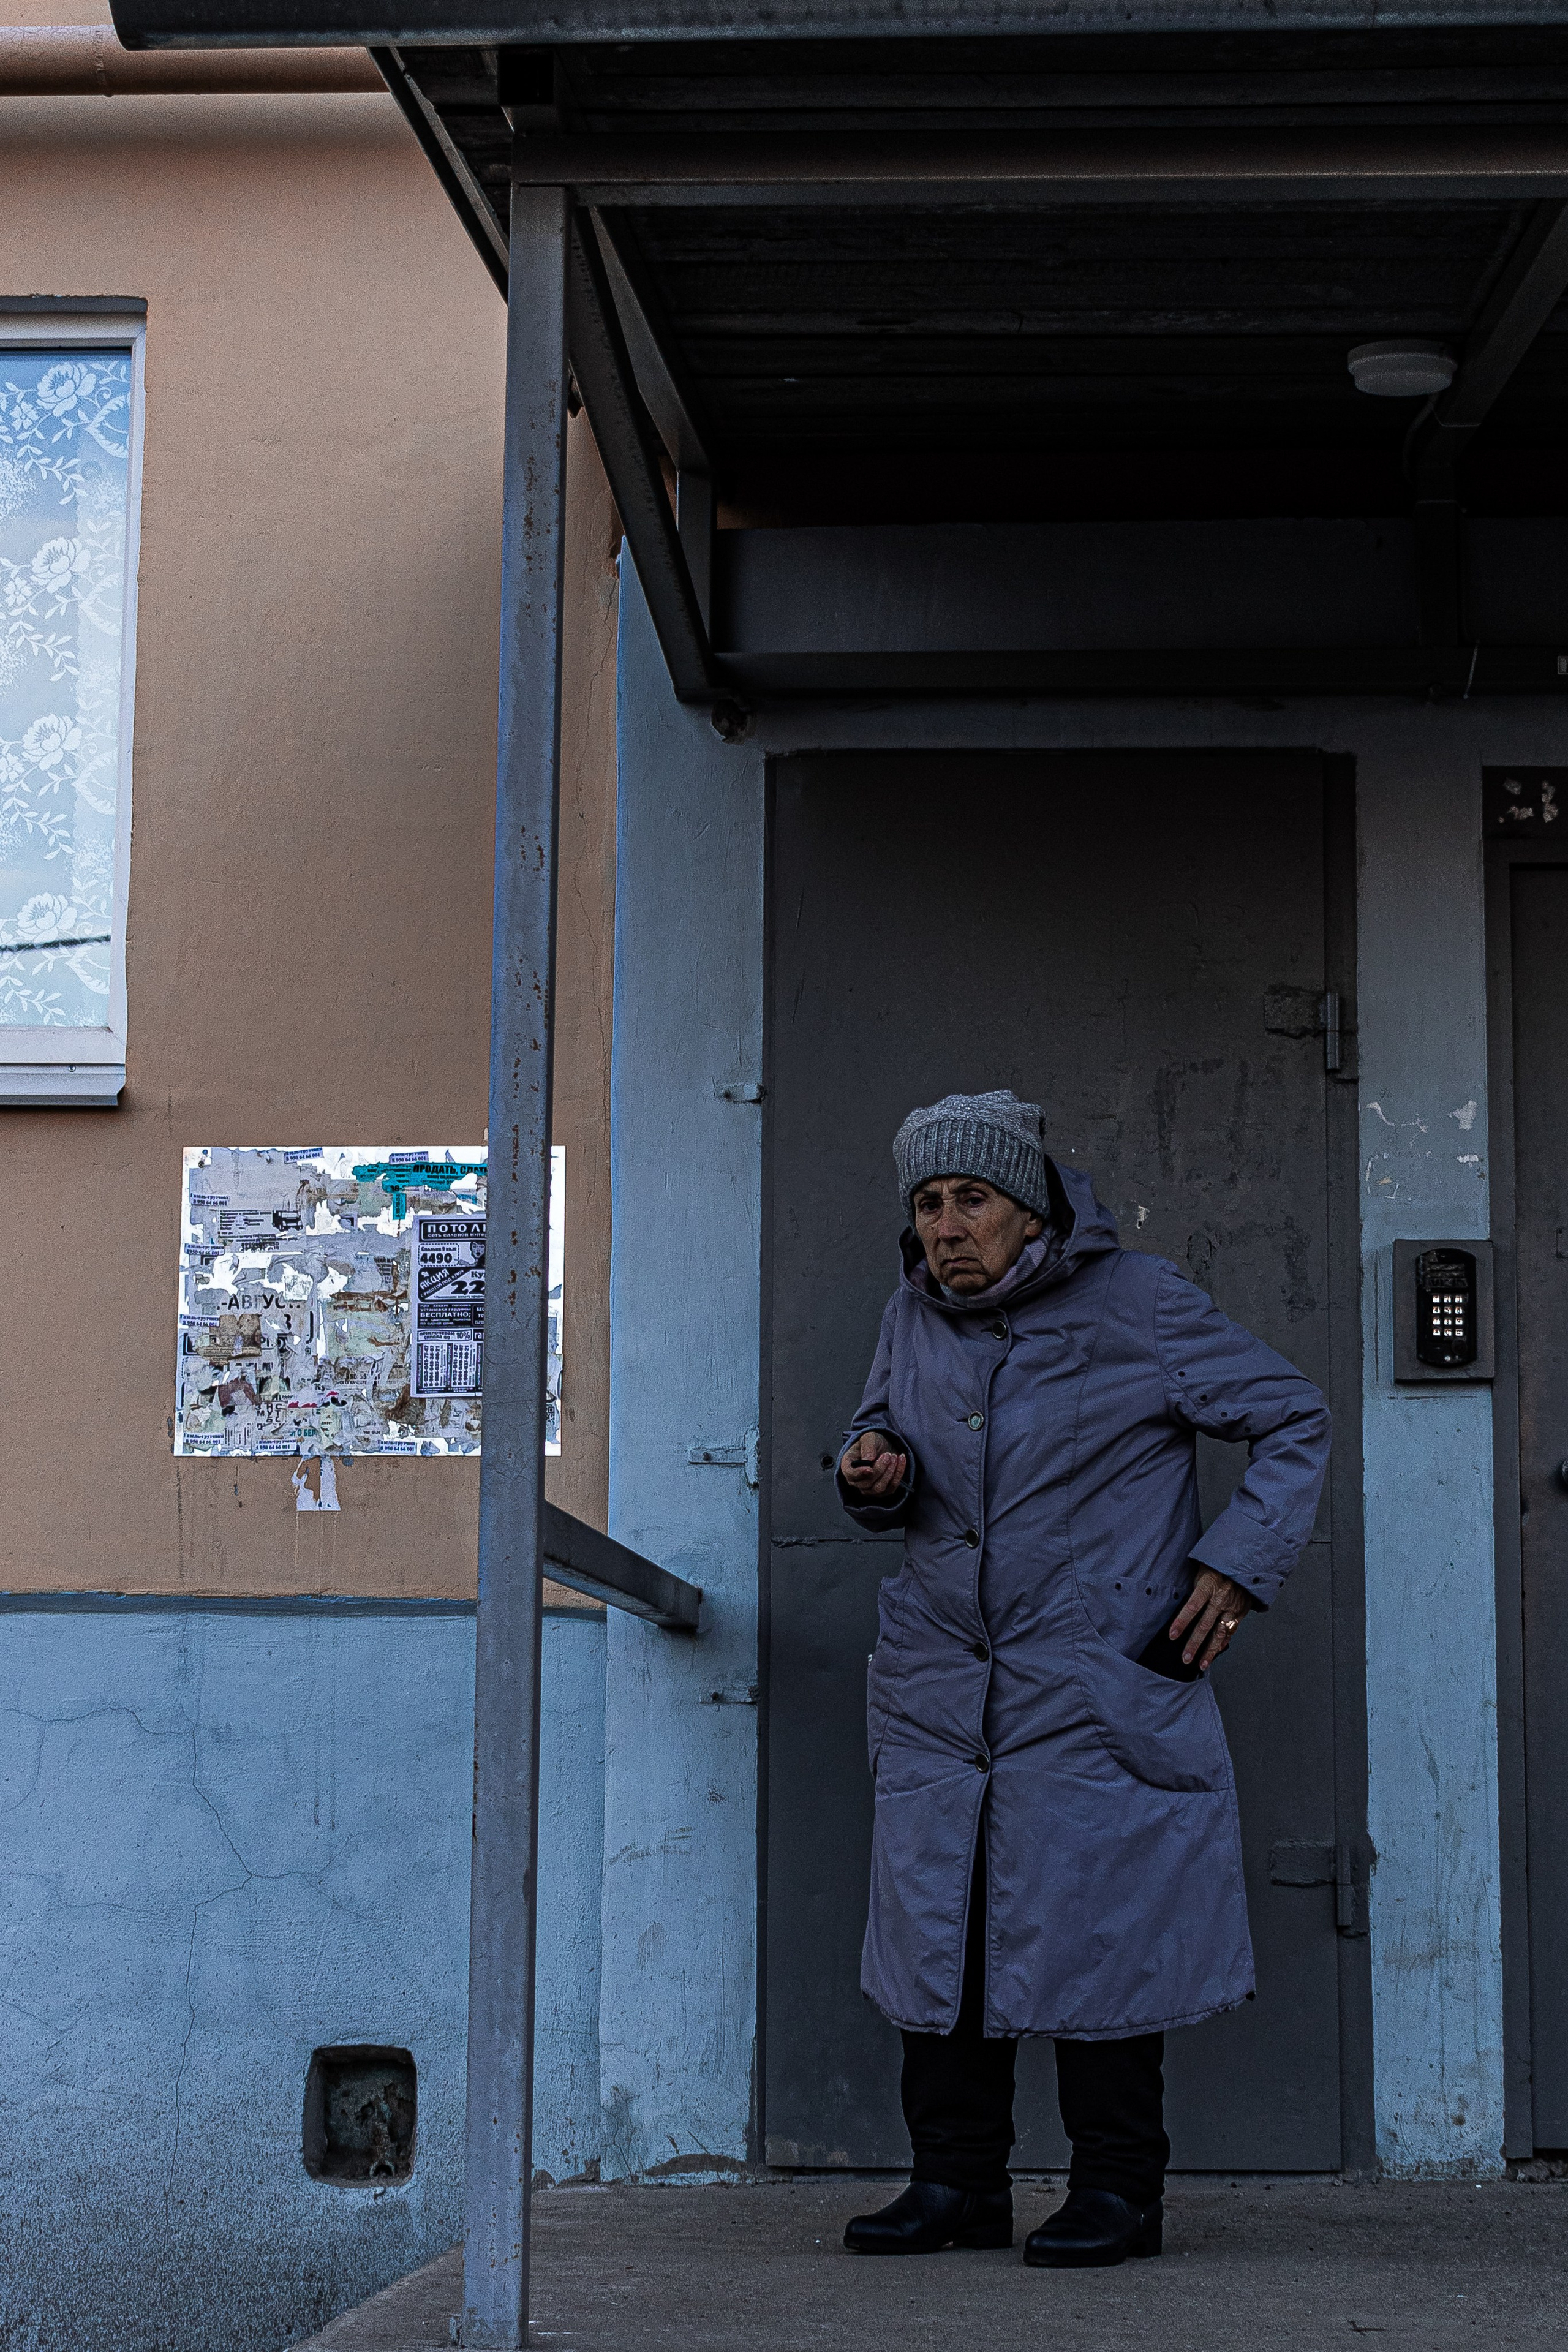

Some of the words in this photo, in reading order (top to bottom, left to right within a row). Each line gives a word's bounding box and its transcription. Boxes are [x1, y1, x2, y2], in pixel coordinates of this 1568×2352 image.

[413, 1164, 458, 1175] ПРОДАТЬ,
[420, 1253, 453, 1264] 4490
[420, 1268, 450, 1290] АКЦИЯ
